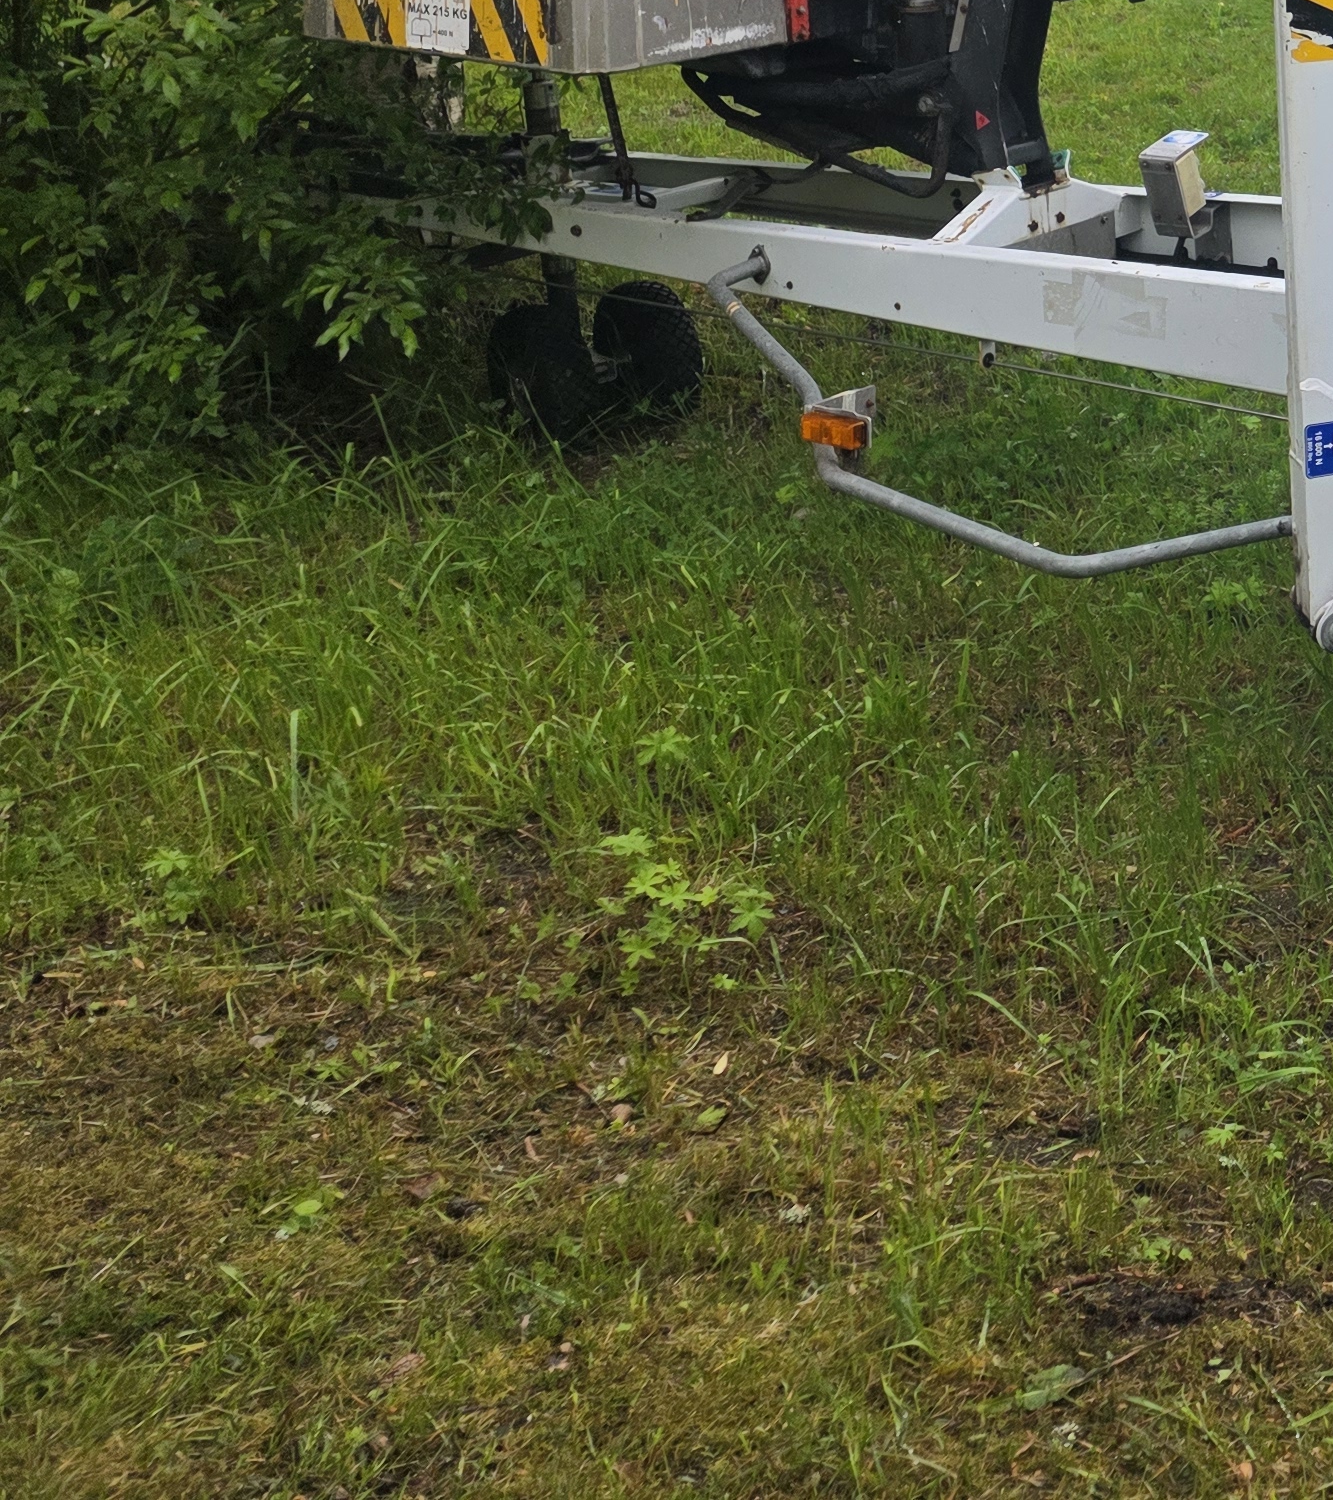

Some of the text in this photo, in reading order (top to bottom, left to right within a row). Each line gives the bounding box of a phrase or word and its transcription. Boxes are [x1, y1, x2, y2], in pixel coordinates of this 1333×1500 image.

[408, 2, 468, 20] MAX 215 KG
[1315, 458, 1323, 466] N
